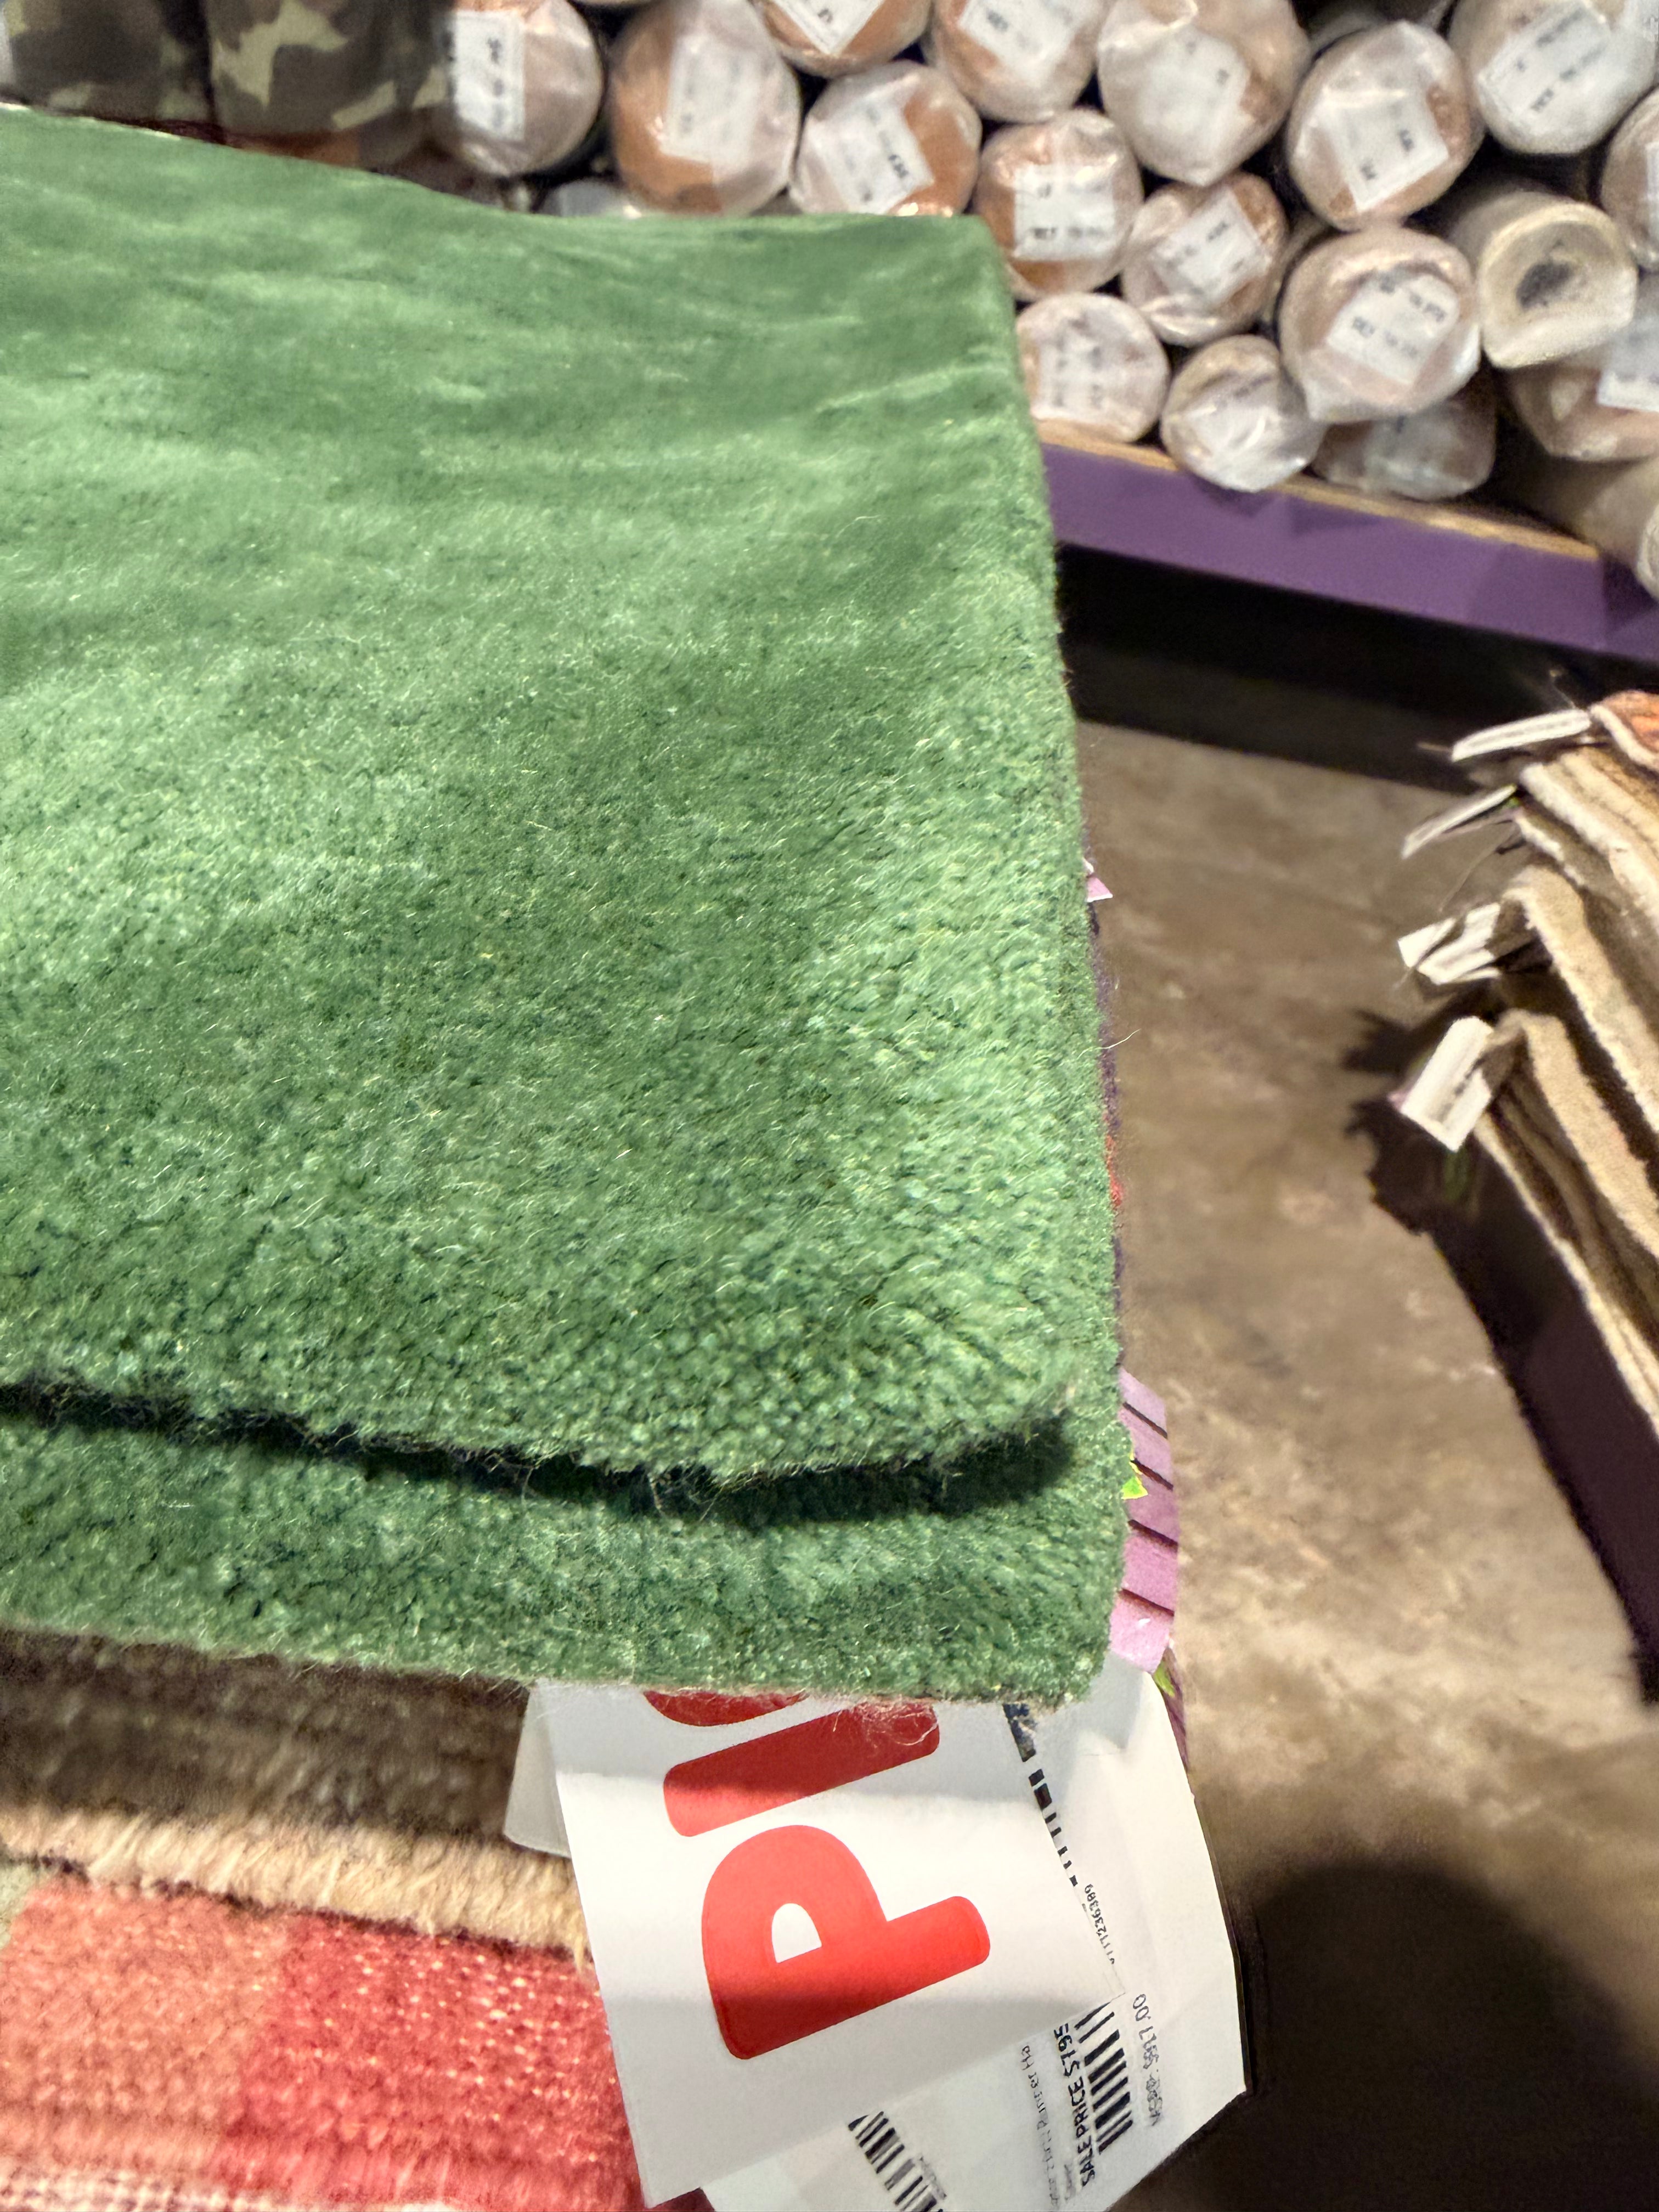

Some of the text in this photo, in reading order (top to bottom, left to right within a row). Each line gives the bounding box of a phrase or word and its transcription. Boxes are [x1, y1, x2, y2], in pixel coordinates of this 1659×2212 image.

[643, 1690, 990, 2061] PI
[1068, 2076, 1089, 2138] PRICE
[1077, 2136, 1096, 2187] SALE
